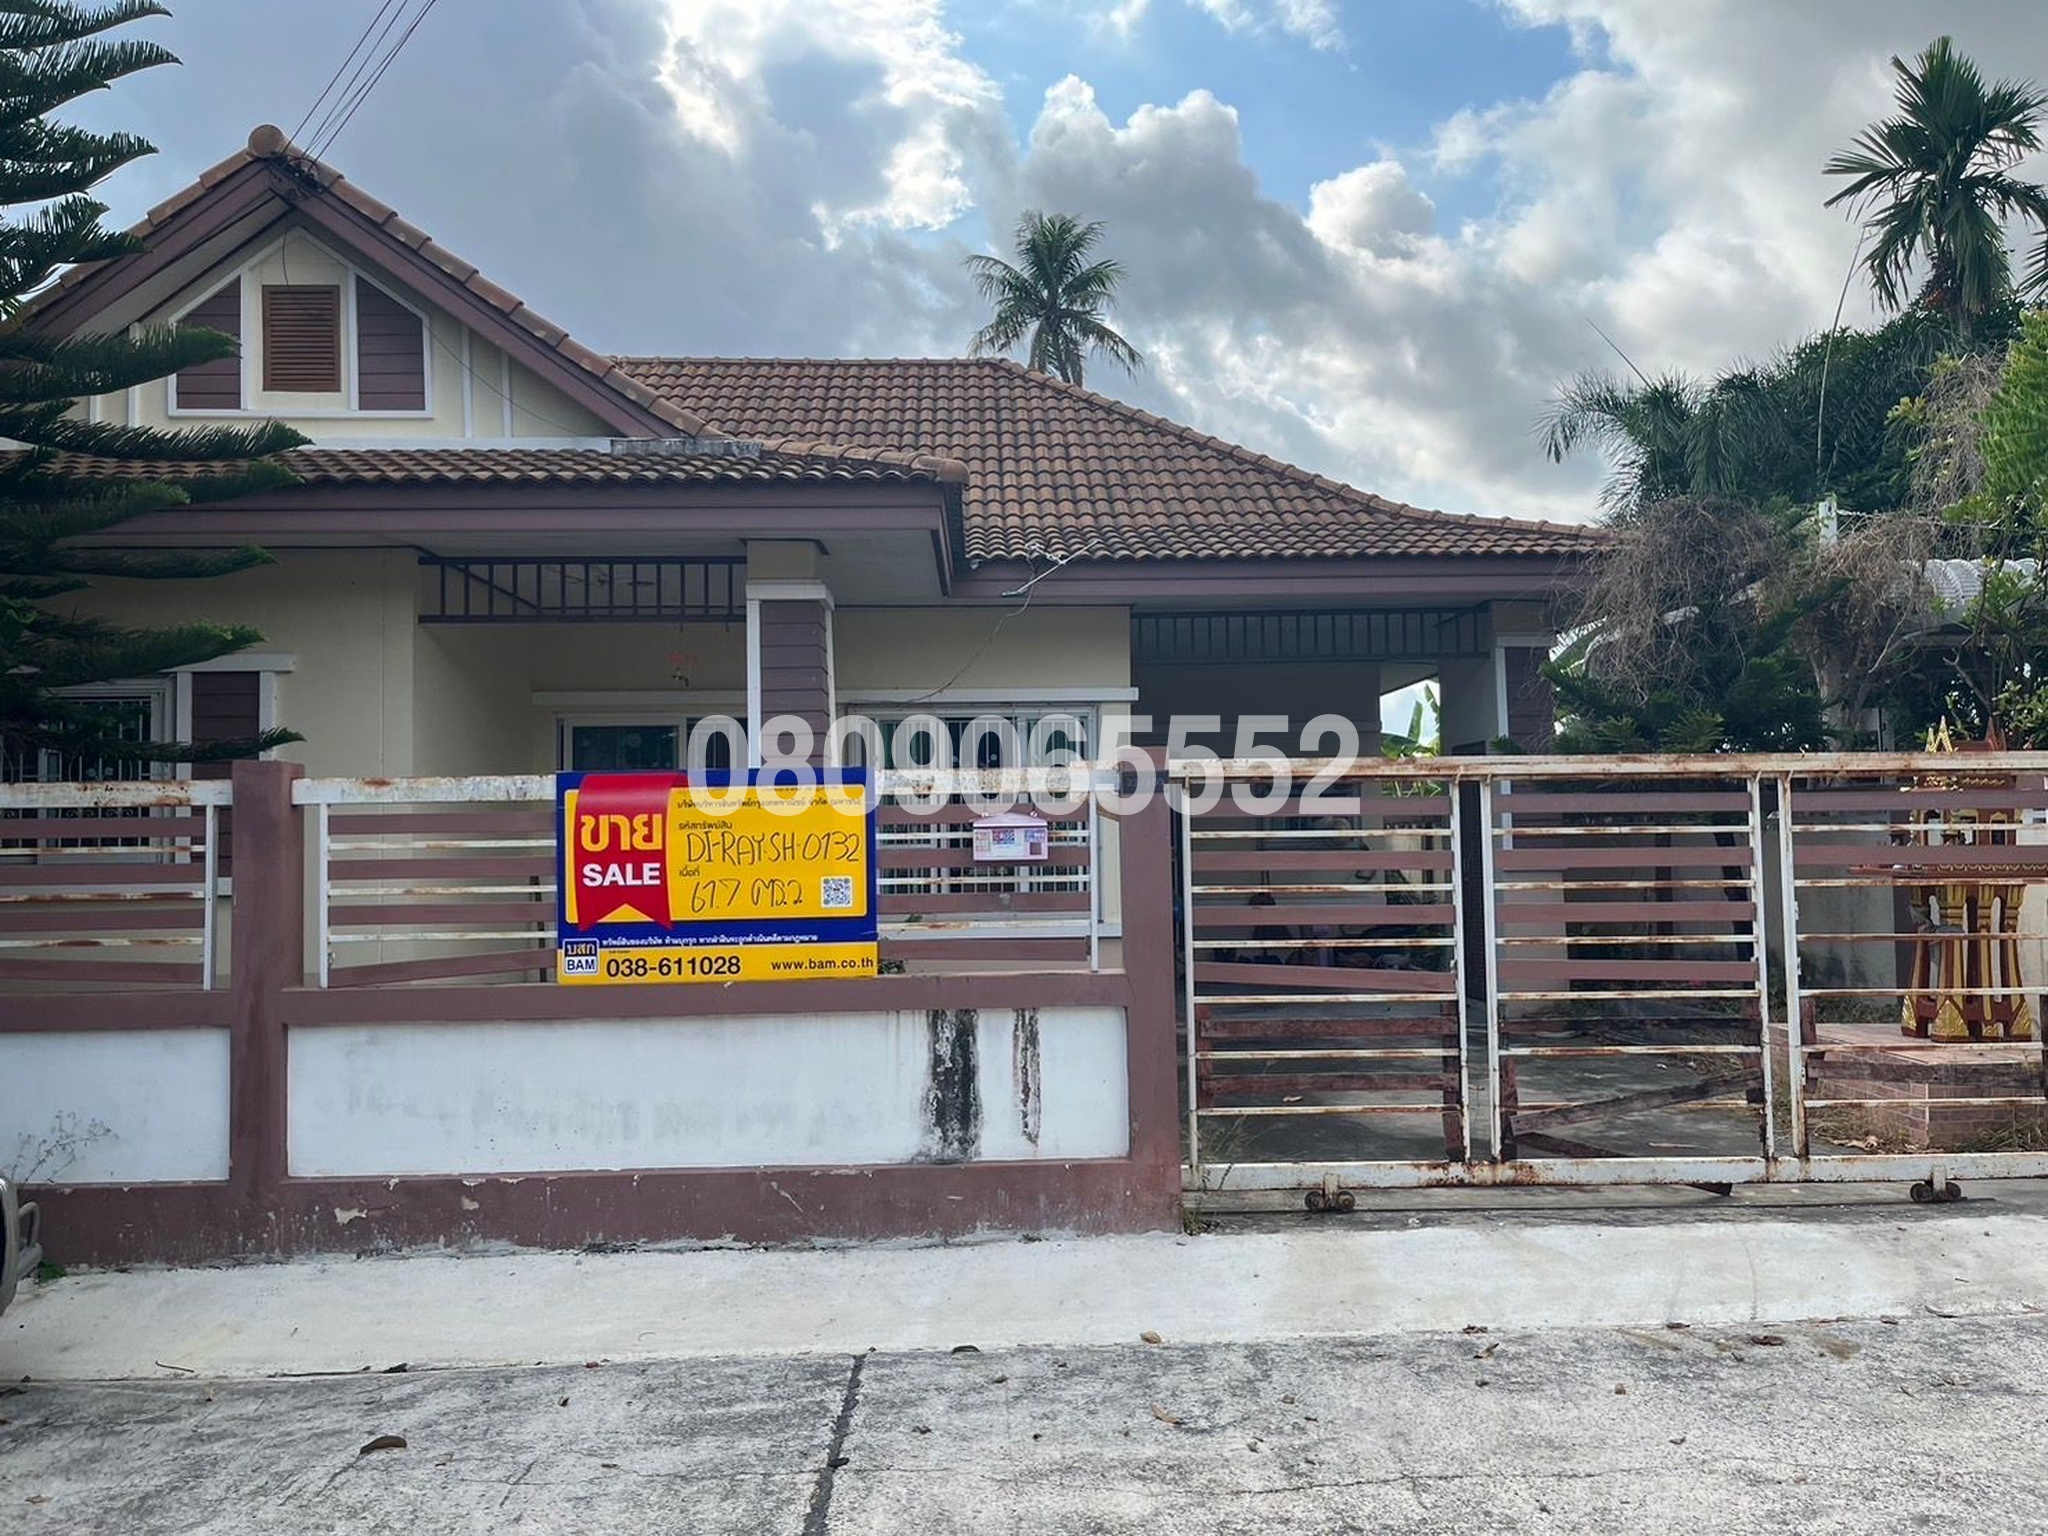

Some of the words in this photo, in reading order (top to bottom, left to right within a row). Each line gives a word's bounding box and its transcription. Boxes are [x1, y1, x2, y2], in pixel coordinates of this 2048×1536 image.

[580, 813, 663, 851] ขาย
[678, 819, 733, 830] รหัสทรัพย์สิน
[582, 863, 661, 887] SALE
[678, 865, 700, 877] เนื้อที่
[566, 944, 596, 956] บสก
[566, 957, 596, 972] BAM
[606, 956, 741, 978] 038-611028
[770, 956, 874, 971] www.bam.co.th
